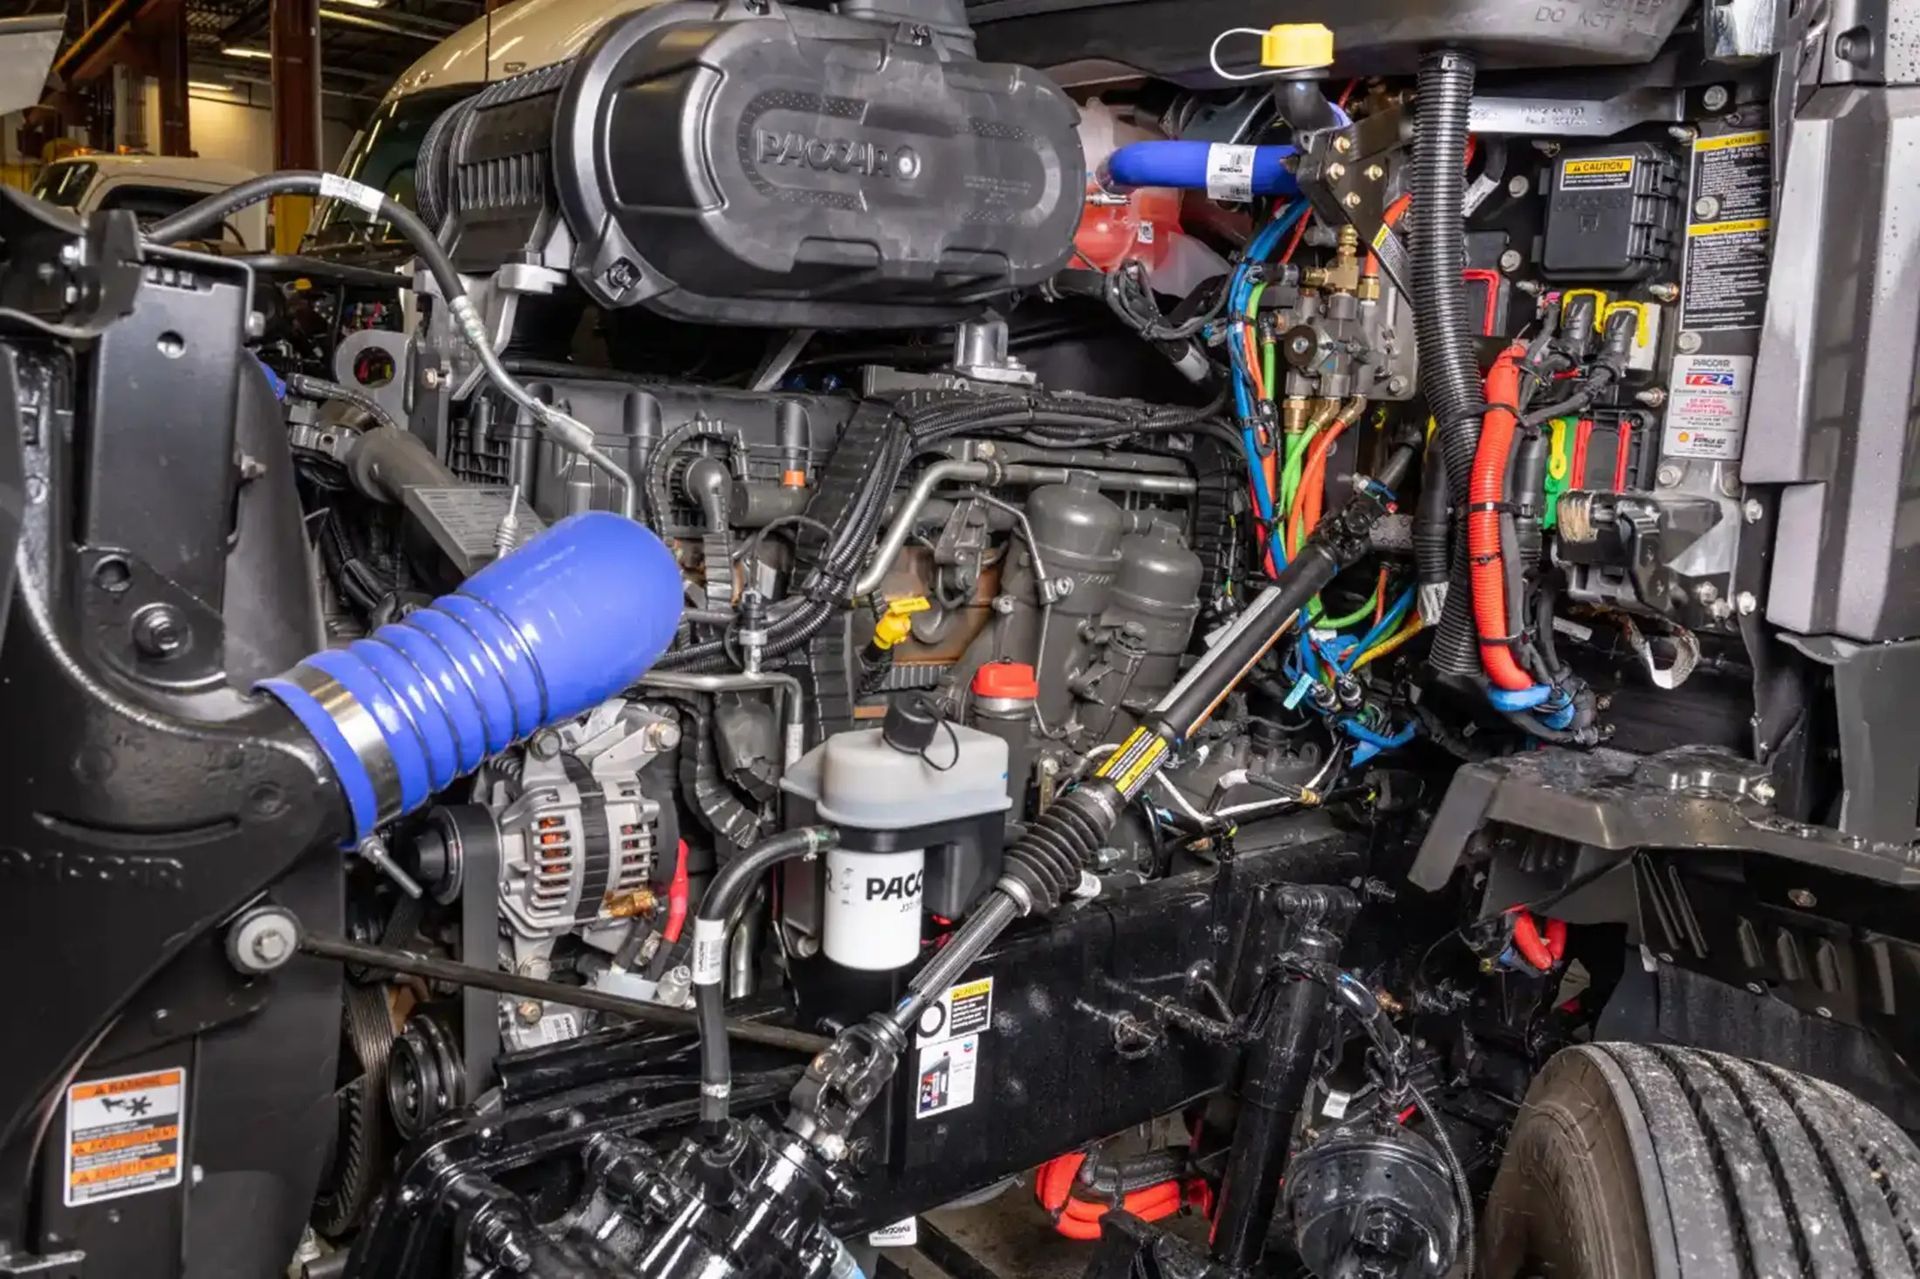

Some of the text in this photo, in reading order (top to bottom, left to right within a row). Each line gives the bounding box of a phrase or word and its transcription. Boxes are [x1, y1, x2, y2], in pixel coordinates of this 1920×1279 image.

[1535, 6, 1566, 23] DO
[1578, 9, 1615, 31] NOT
[756, 128, 891, 178] PACCAR
[1583, 161, 1624, 172] CAUTION
